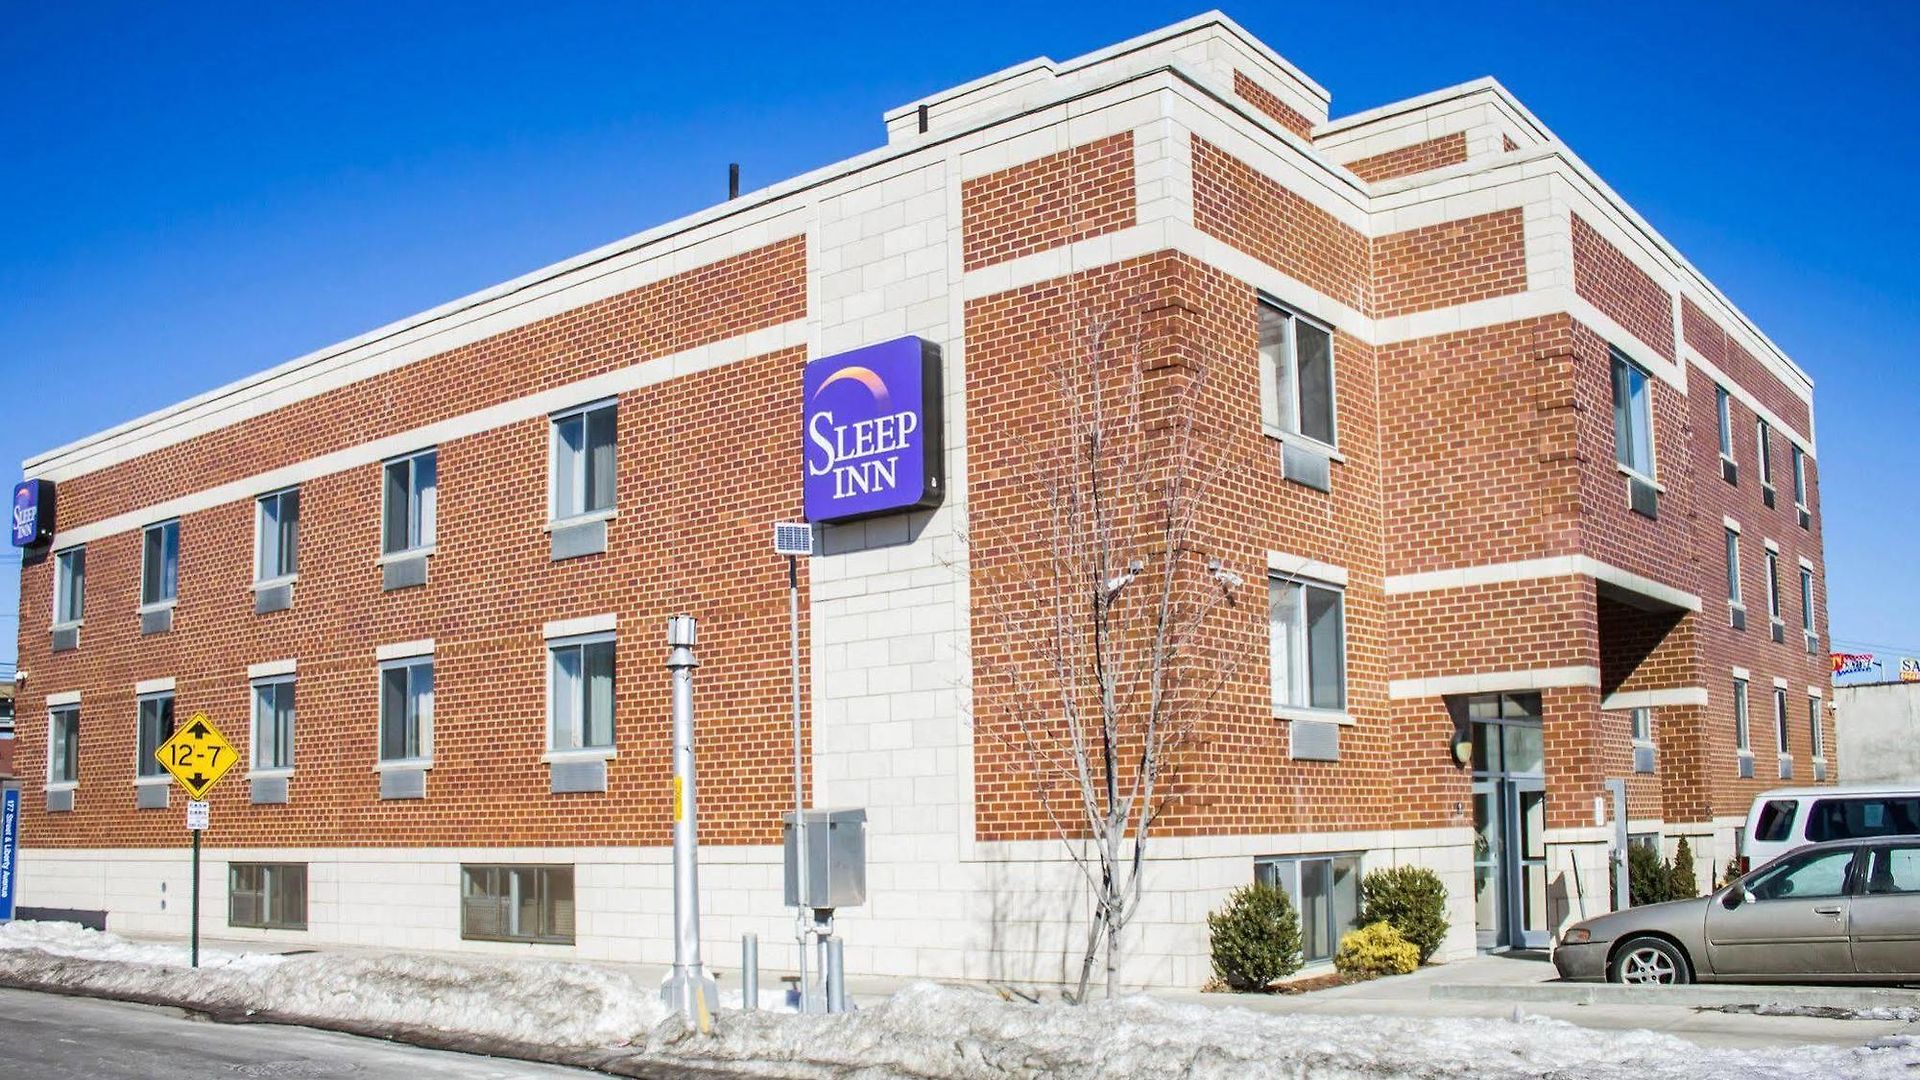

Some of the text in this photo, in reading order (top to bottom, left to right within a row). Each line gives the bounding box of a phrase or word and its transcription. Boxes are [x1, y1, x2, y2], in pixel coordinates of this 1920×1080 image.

[809, 410, 918, 476] SLEEP
[833, 456, 899, 499] INN
[6, 799, 15, 811] 177
[5, 813, 14, 835] Street
[2, 844, 12, 869] Liberty
[1, 870, 10, 898] Avenue
